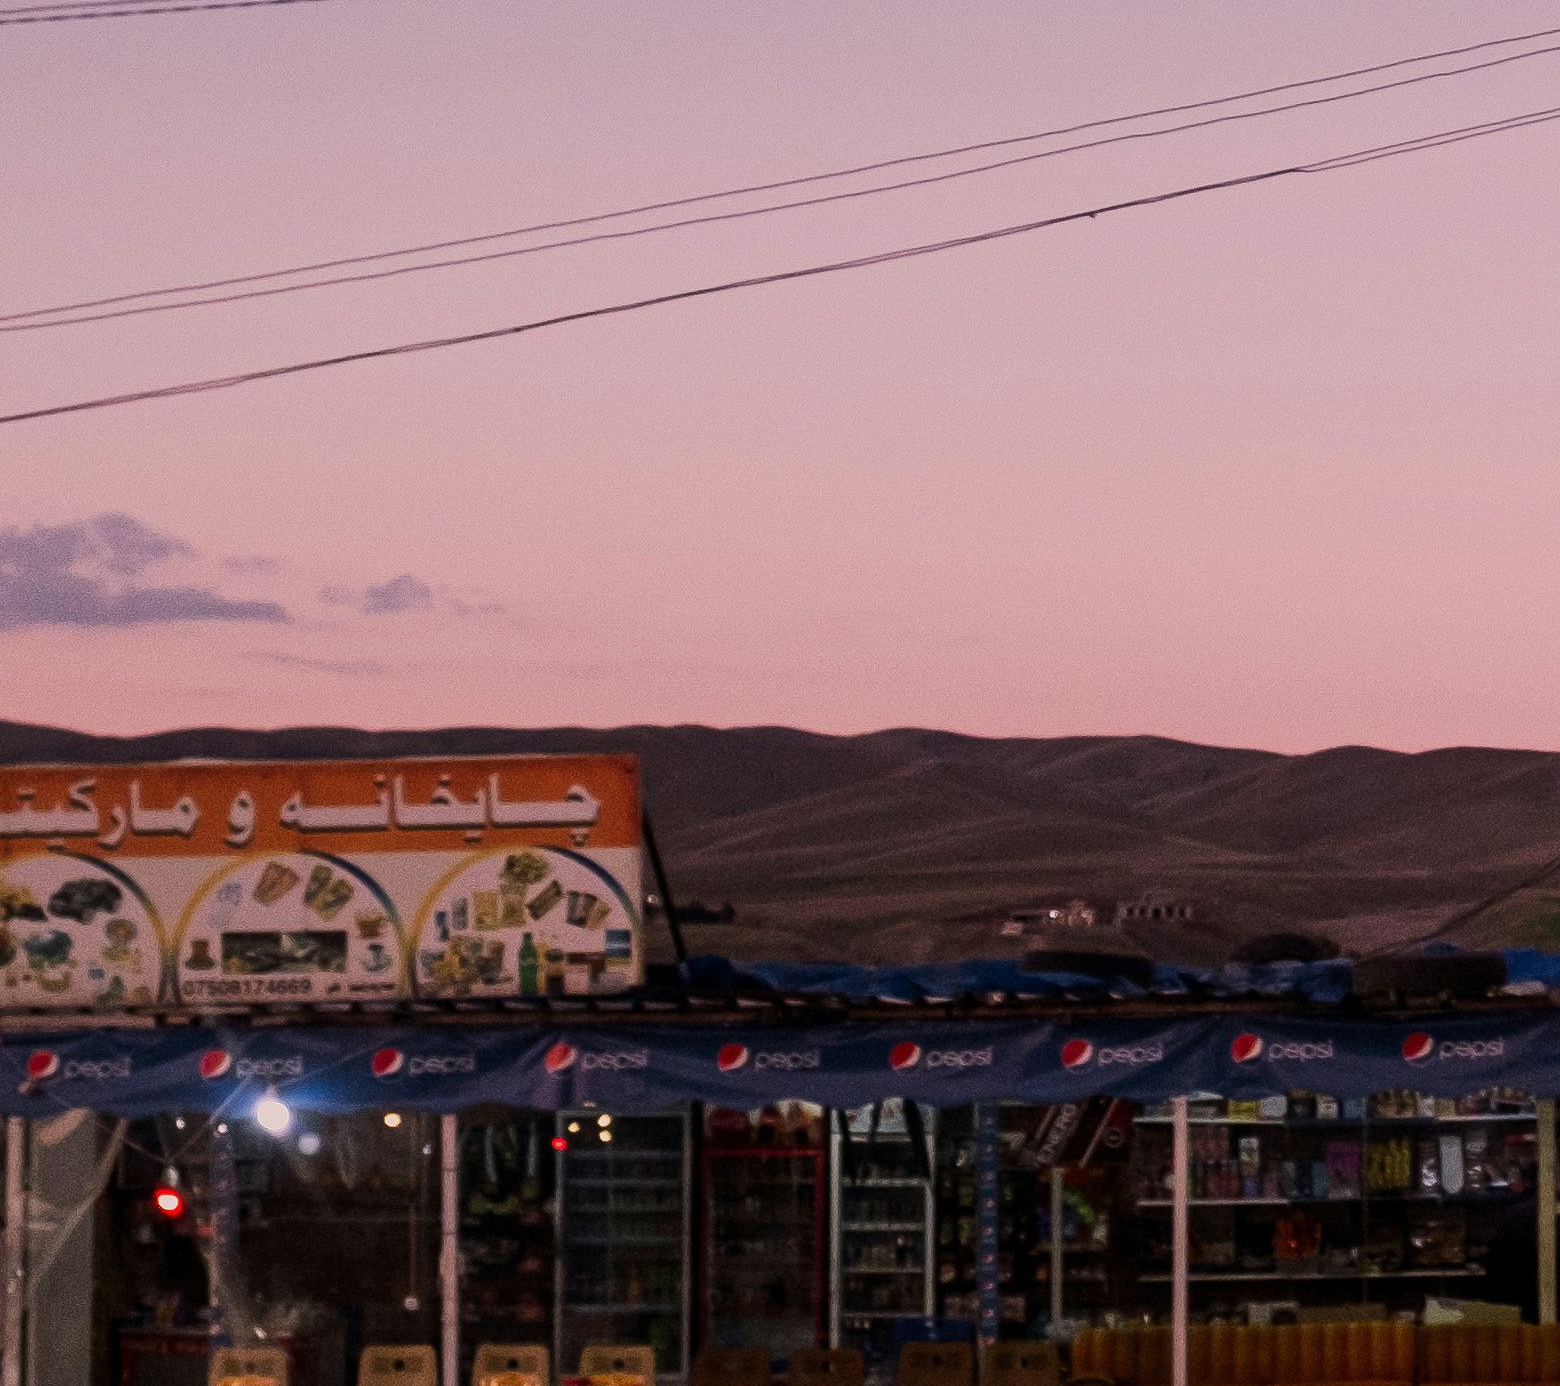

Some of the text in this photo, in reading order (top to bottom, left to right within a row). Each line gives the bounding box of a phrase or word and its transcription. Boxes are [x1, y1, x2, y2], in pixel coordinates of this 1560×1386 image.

[223, 789, 256, 848] و
[926, 1046, 993, 1070] pepsi
[1098, 1043, 1163, 1067] pepsi
[1268, 1039, 1333, 1062] pepsi
[1440, 1036, 1504, 1060] pepsi
[64, 1056, 132, 1078] pepsi
[236, 1055, 303, 1078] pepsi
[408, 1053, 476, 1076] pepsi
[581, 1048, 650, 1073] pepsi
[754, 1049, 820, 1073] pepsi
